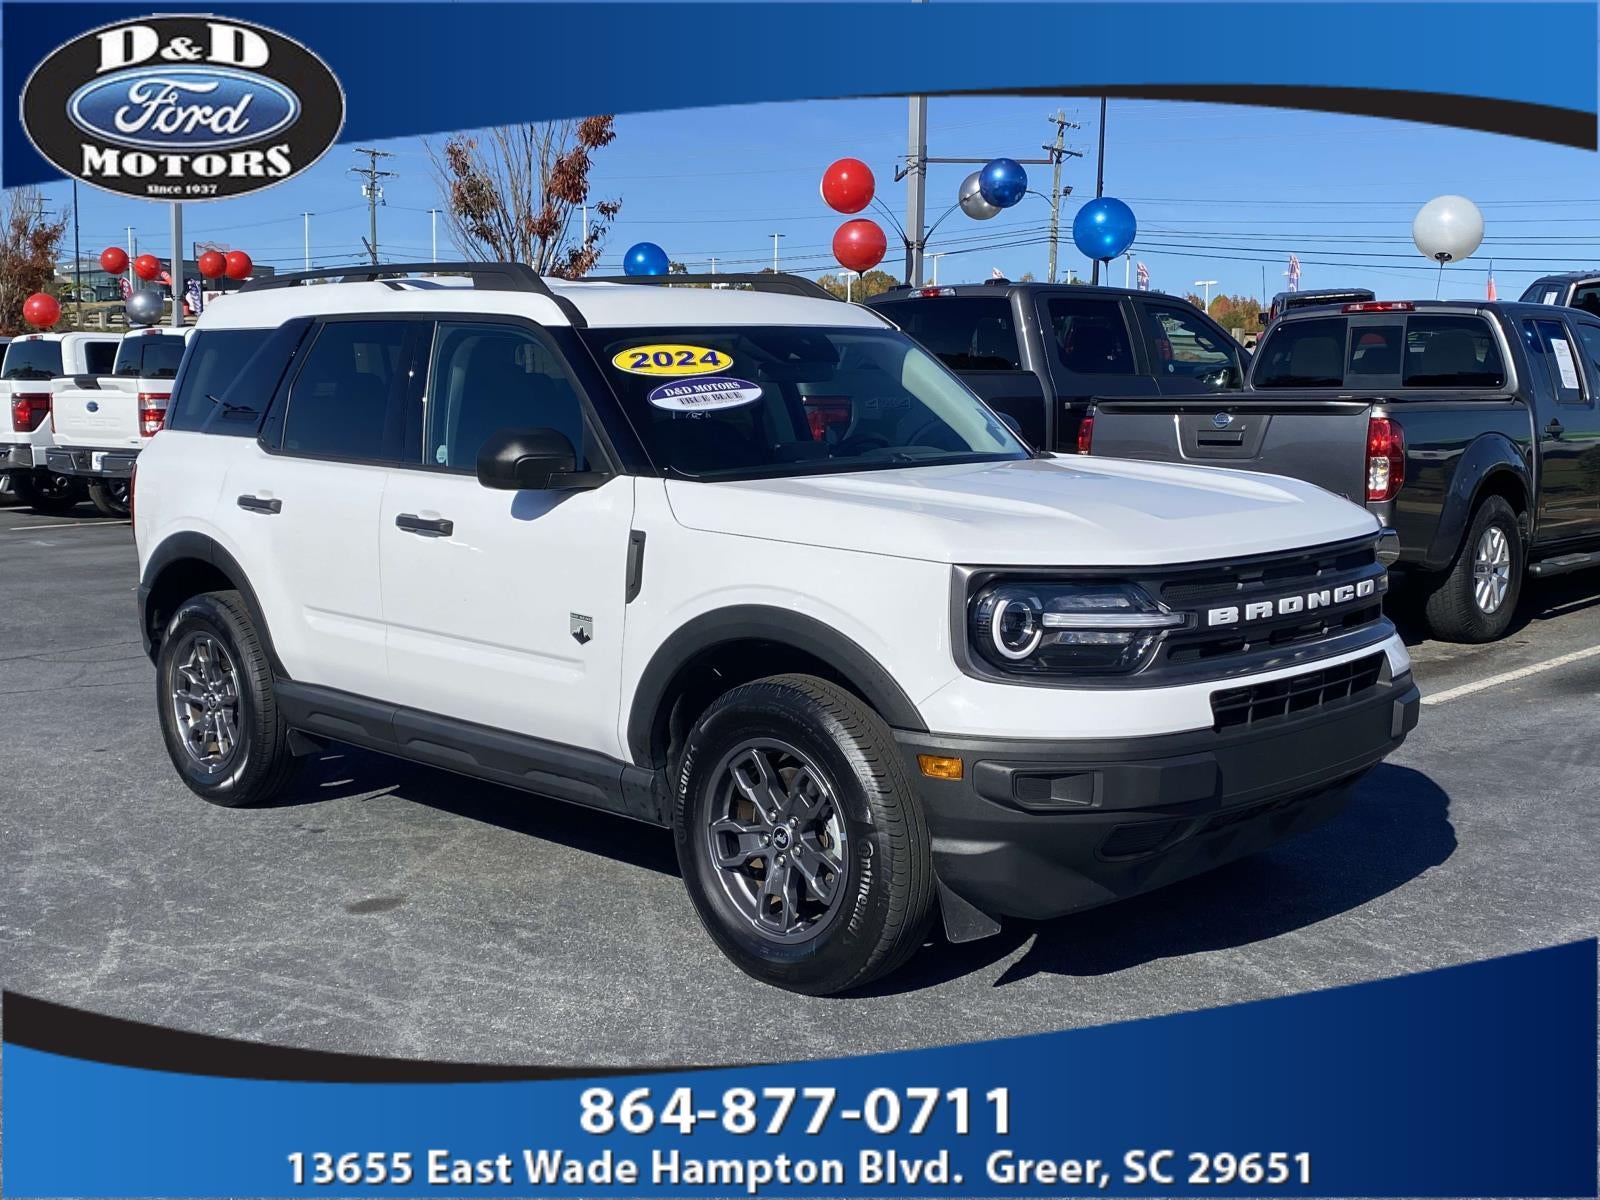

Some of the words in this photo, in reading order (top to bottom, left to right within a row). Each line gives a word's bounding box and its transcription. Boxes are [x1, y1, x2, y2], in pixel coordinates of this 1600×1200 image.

[629, 350, 721, 369] 2024
[664, 385, 692, 397] D&D
[694, 381, 741, 394] MOTORS
[677, 393, 711, 406] TRUE
[712, 391, 743, 402] BLUE
[1208, 579, 1375, 626] BRONCO
